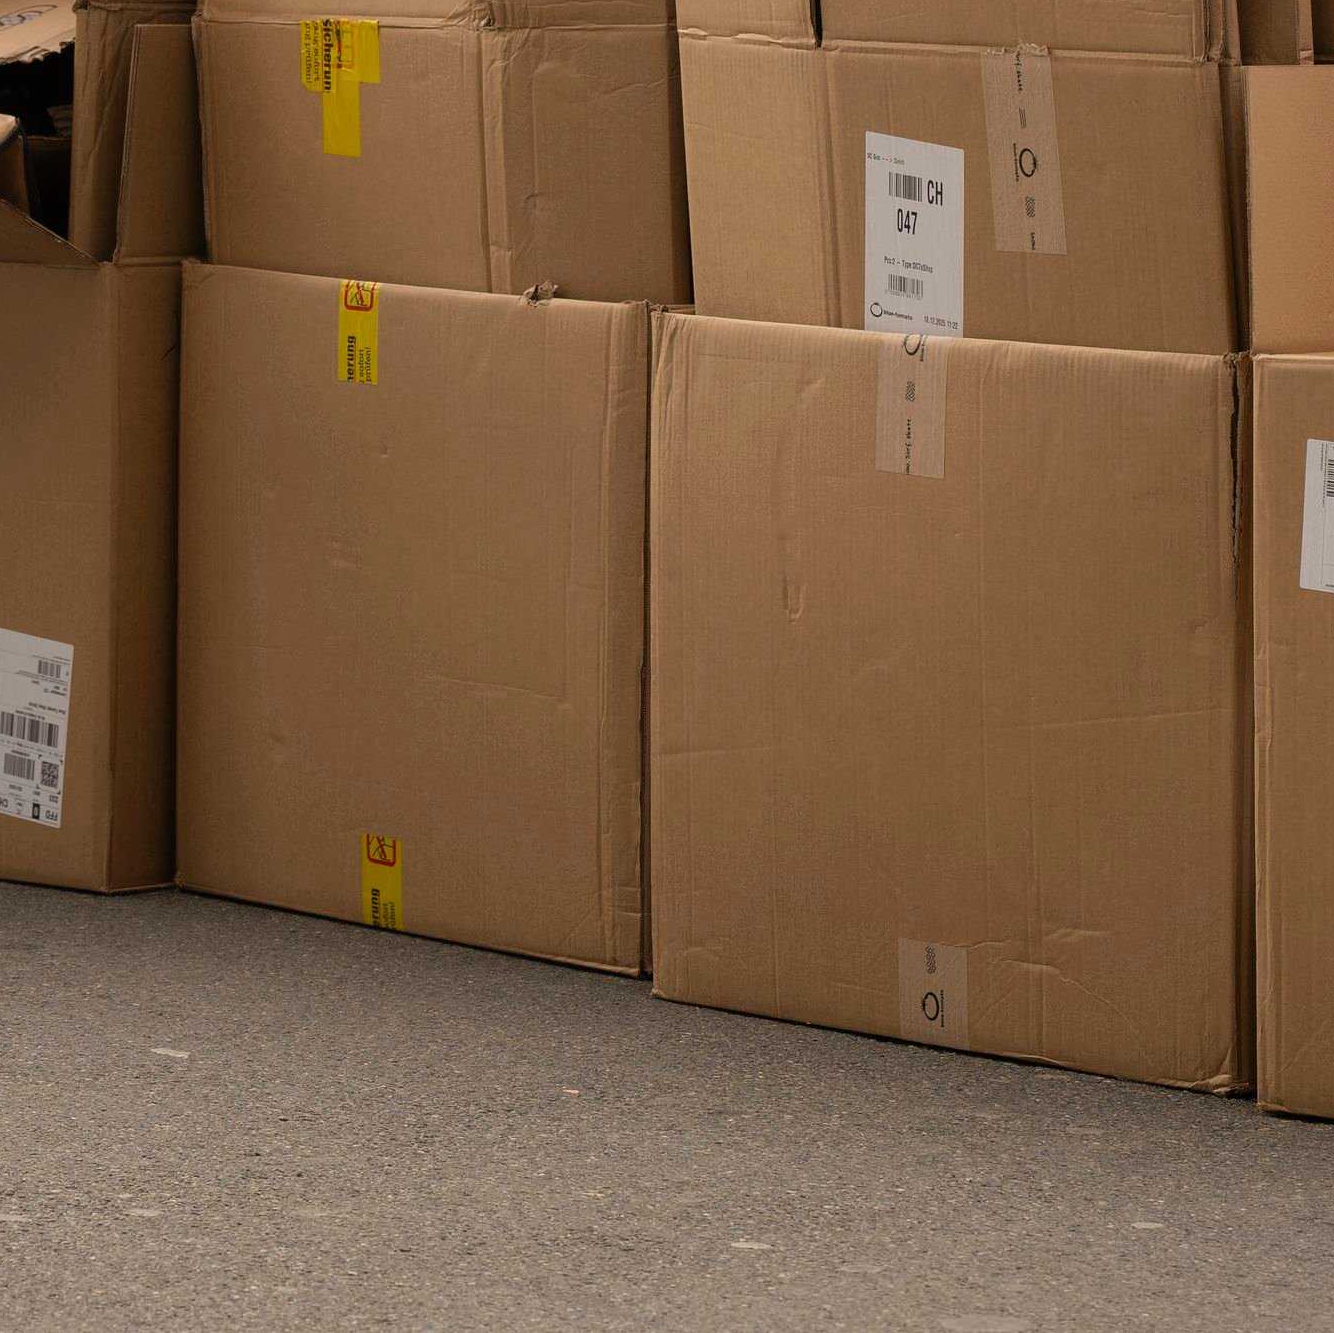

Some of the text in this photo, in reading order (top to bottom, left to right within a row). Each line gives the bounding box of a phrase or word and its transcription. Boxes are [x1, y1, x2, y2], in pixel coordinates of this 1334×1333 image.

[926, 179, 943, 206] CH
[896, 207, 918, 235] 047
[883, 309, 913, 321] blue-tomato
[0, 797, 10, 810] CH
[45, 809, 59, 822] FFD
